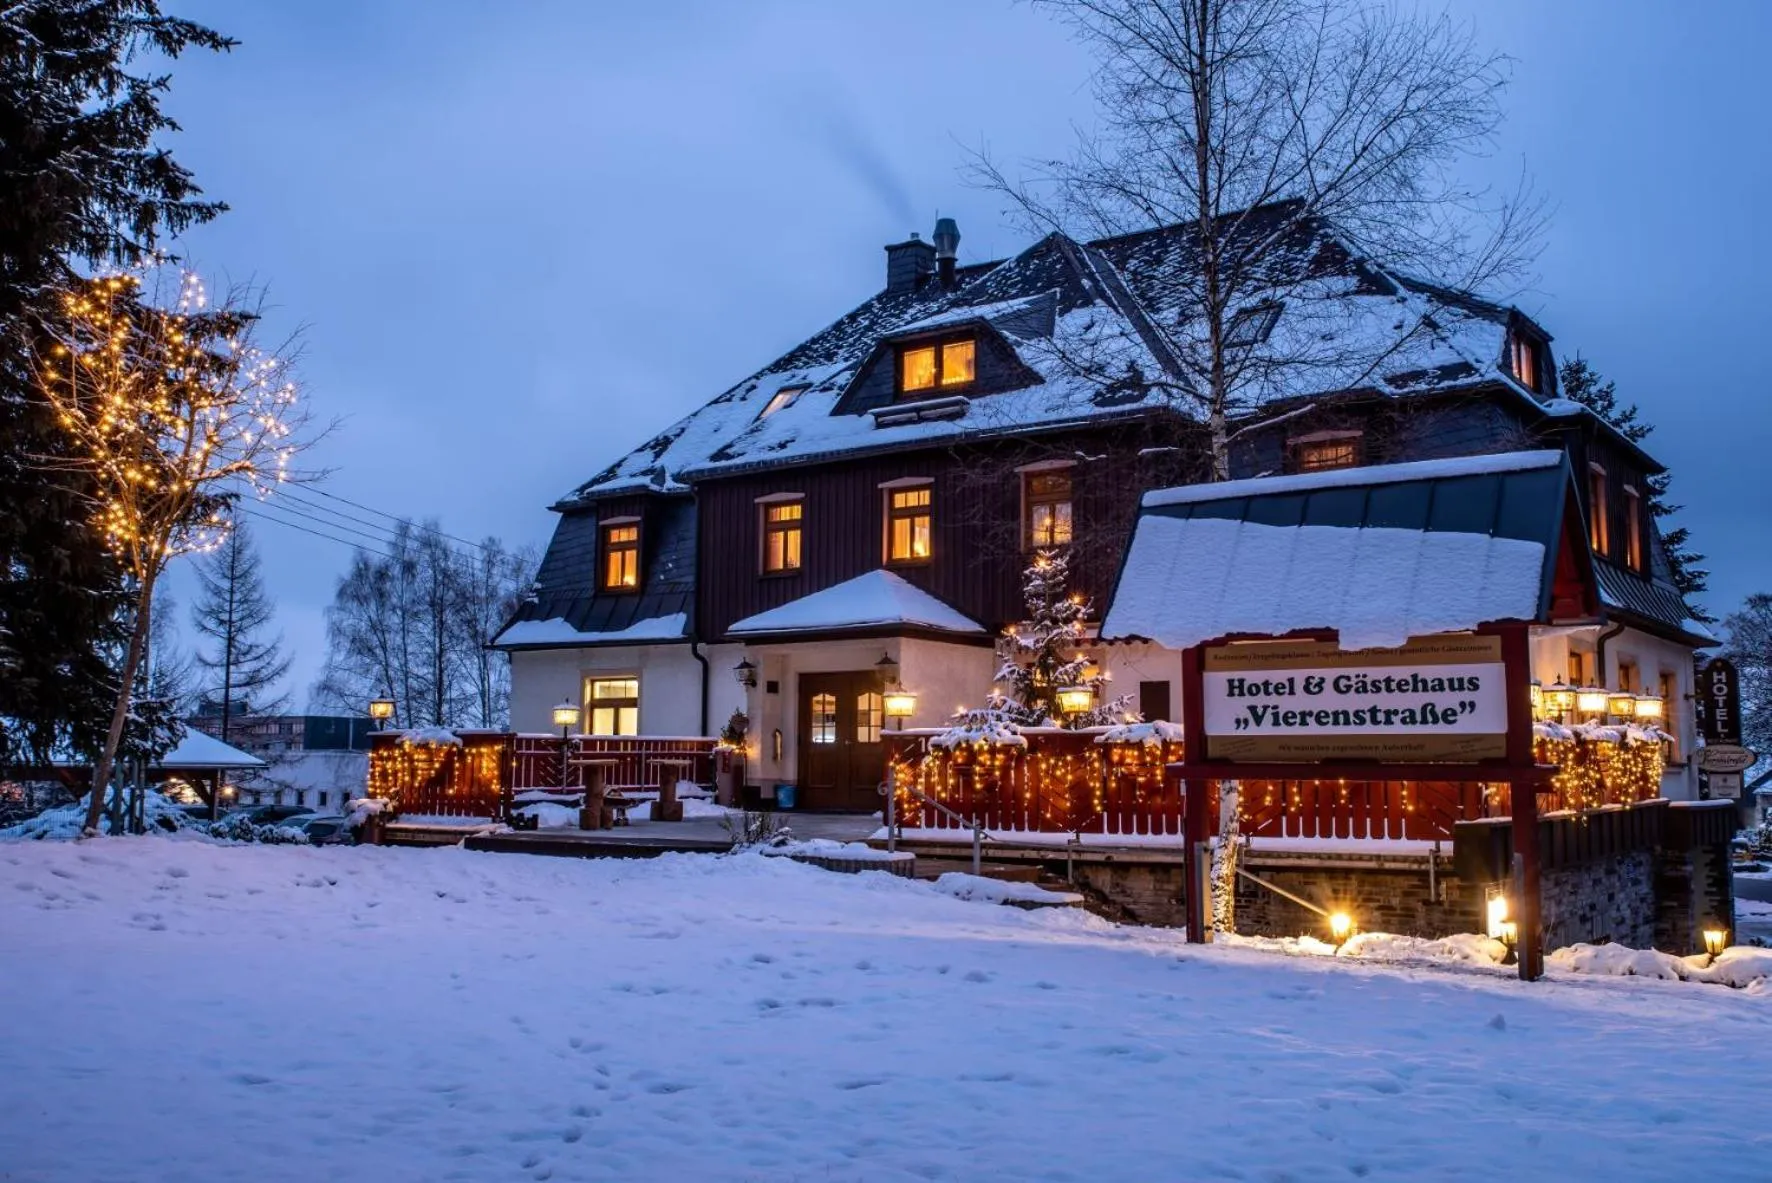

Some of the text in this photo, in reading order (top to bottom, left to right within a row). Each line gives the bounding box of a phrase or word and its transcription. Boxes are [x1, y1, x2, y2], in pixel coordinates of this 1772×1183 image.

[1226, 672, 1481, 698] Hotel & Gästehaus
[1712, 671, 1729, 733] HOTEL
